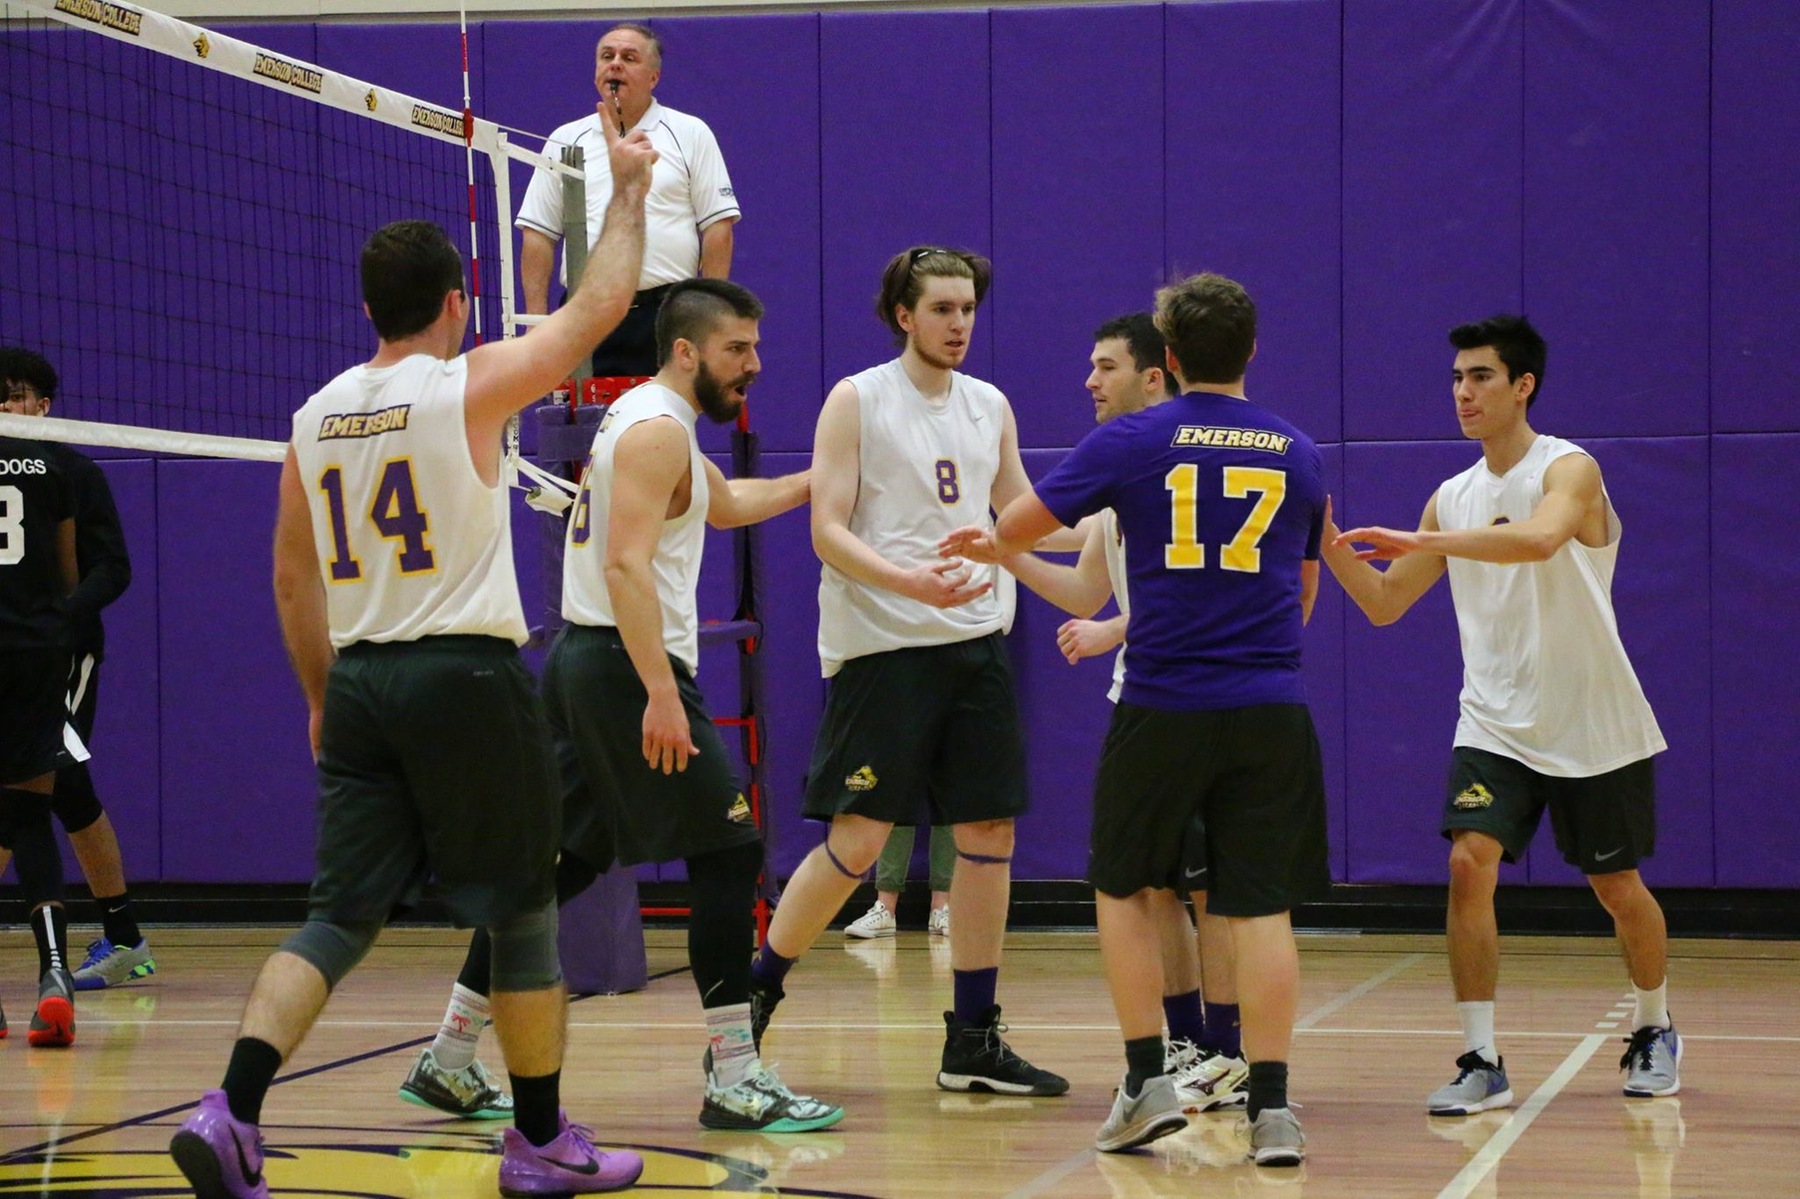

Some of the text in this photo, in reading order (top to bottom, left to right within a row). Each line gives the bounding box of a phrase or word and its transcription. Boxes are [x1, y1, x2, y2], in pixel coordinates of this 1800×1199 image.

[102, 3, 141, 35] COLLEGE
[254, 53, 323, 93] EMERSON COLLEGE
[442, 114, 465, 138] COLLEG
[319, 404, 410, 440] EMERSON
[1174, 427, 1288, 453] EMERSON
[934, 458, 961, 506] 8
[318, 455, 438, 585] 14
[1165, 463, 1286, 573] 17
